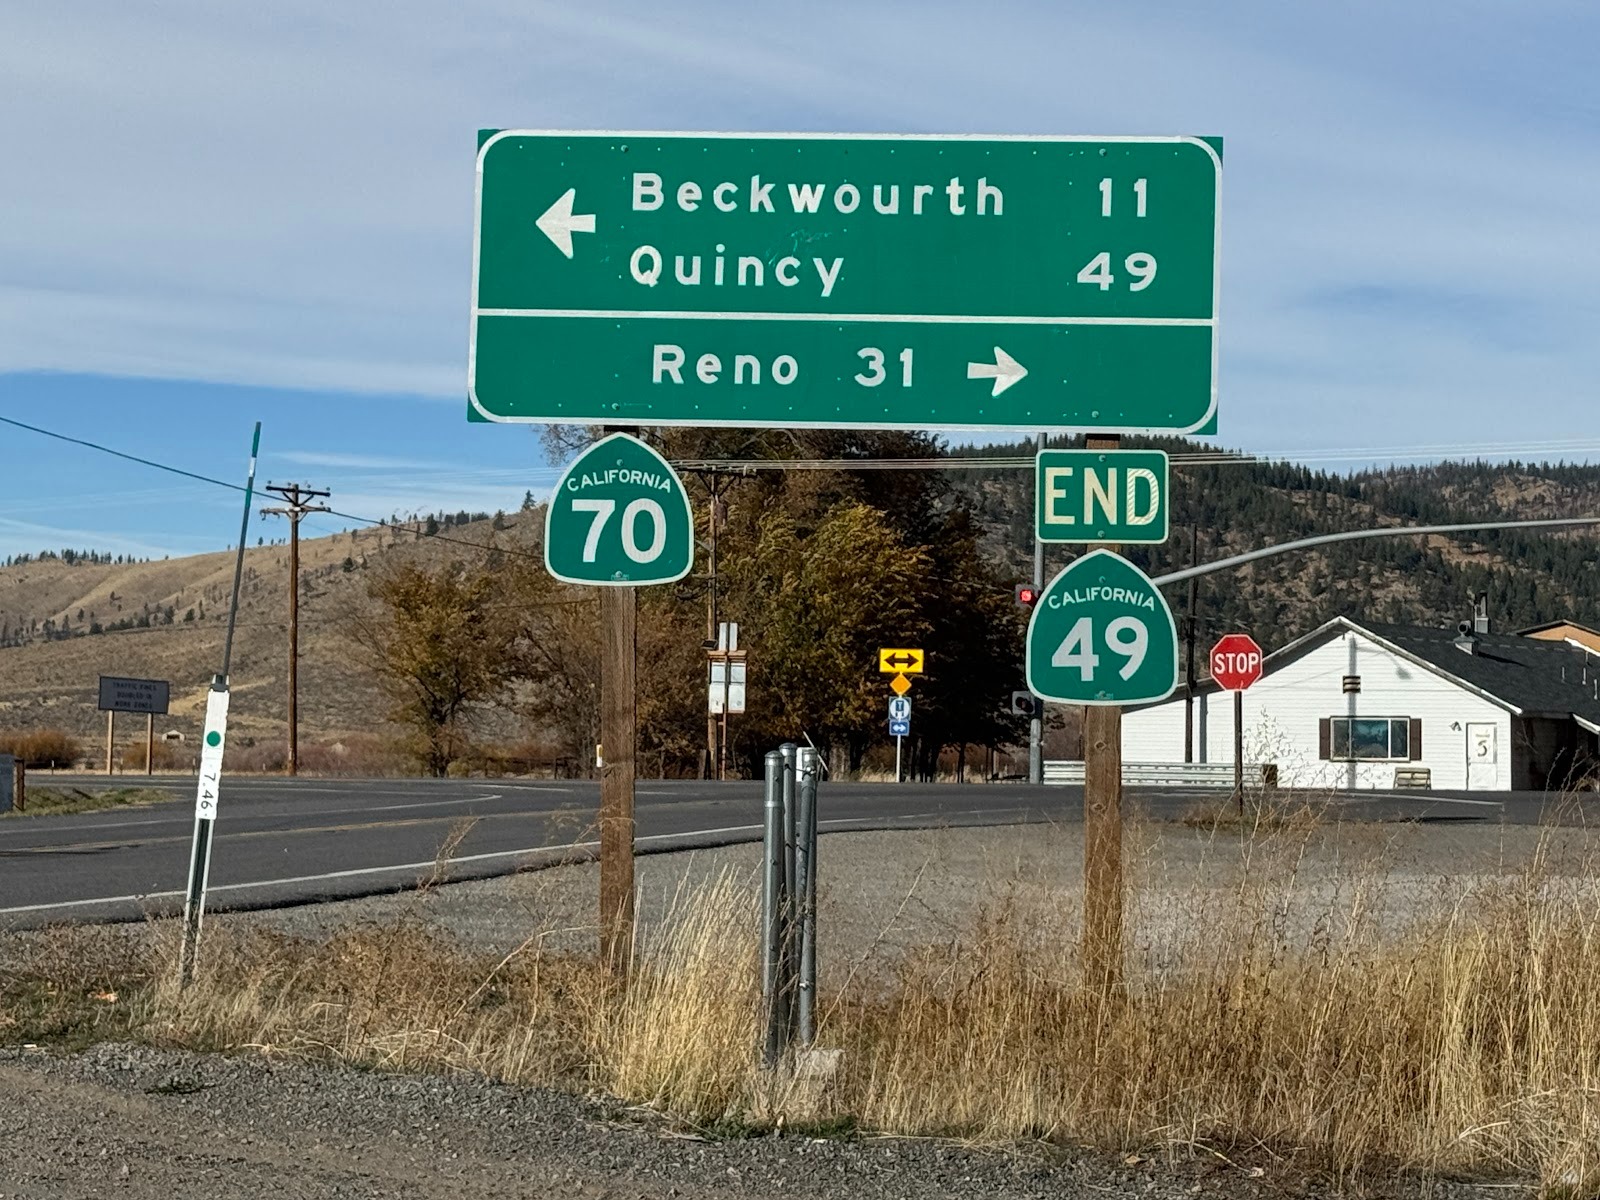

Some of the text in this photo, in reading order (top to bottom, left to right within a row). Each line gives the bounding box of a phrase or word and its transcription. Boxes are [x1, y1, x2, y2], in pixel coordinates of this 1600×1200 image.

[632, 172, 1147, 217] Beckwourth 11
[629, 244, 1157, 297] Quincy 49
[652, 344, 914, 387] Reno 31
[567, 469, 672, 493] CALIFORNIA
[1044, 466, 1160, 526] END
[571, 498, 667, 564] 70
[1047, 586, 1155, 612] CALIFORNIA
[1051, 616, 1149, 682] 49
[1213, 651, 1260, 675] STOP
